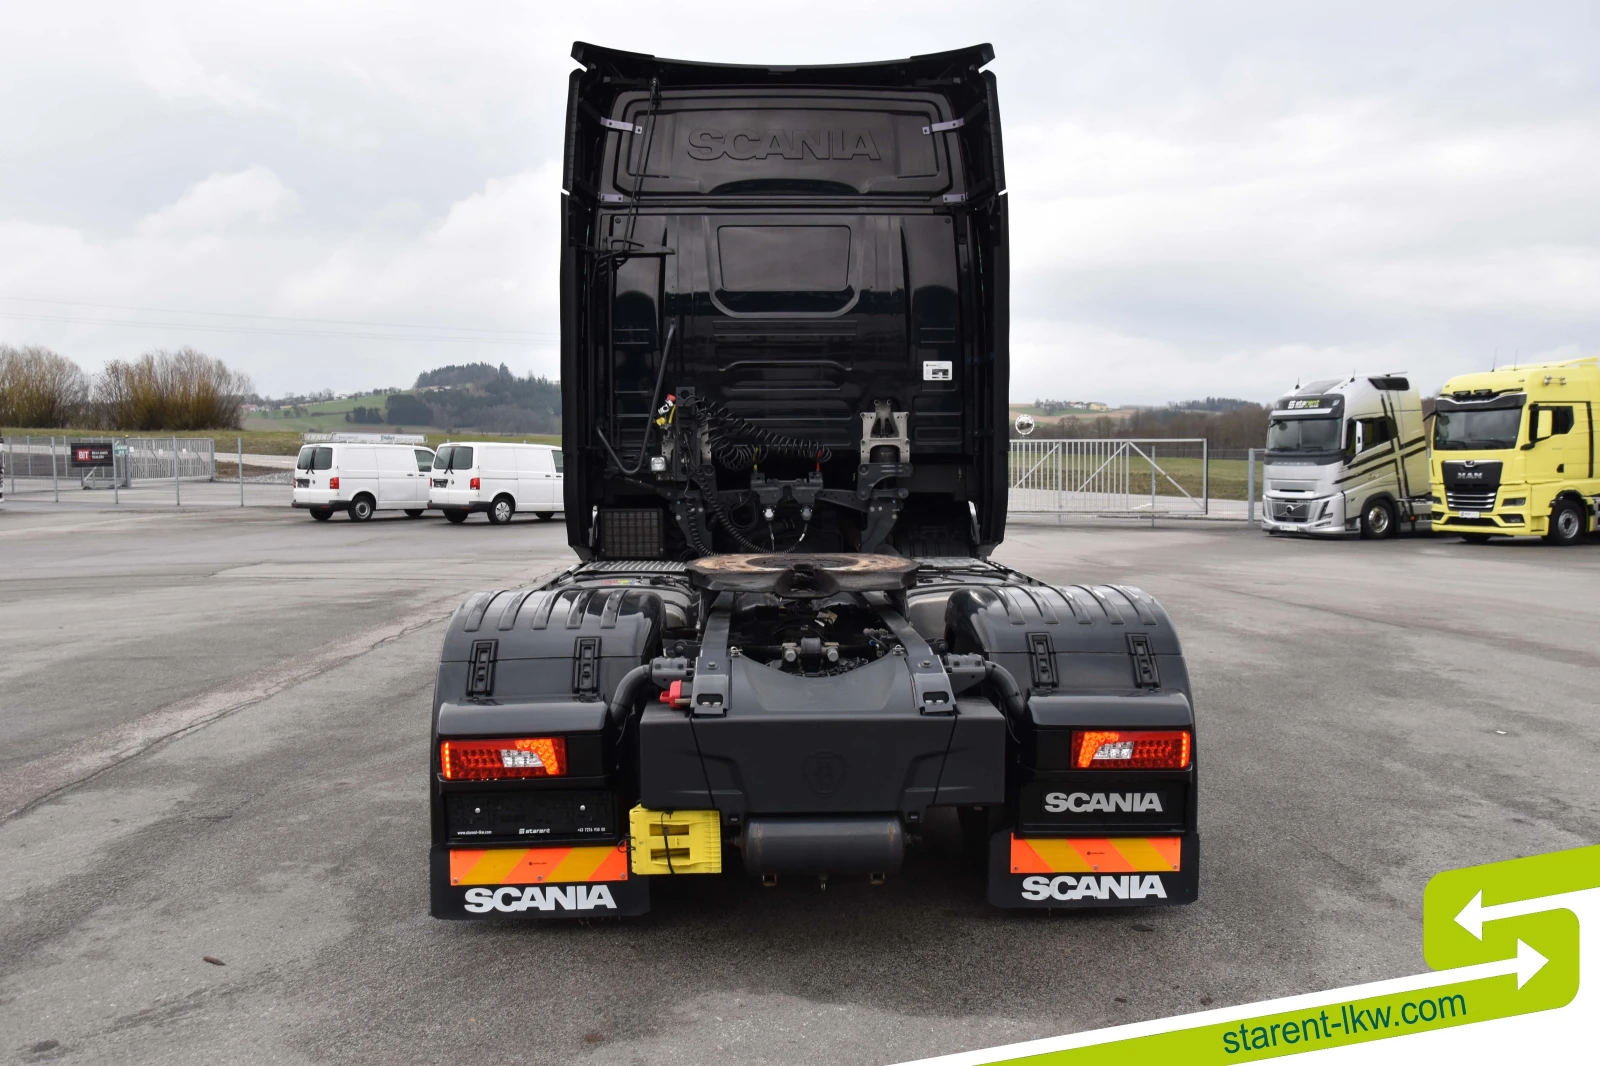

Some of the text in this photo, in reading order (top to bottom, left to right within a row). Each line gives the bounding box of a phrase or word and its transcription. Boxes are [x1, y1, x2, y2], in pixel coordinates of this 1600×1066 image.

[687, 128, 881, 161] SCANIA
[1044, 792, 1163, 813] SCANIA
[464, 884, 617, 913] SCANIA
[1021, 874, 1168, 900] SCANIA
